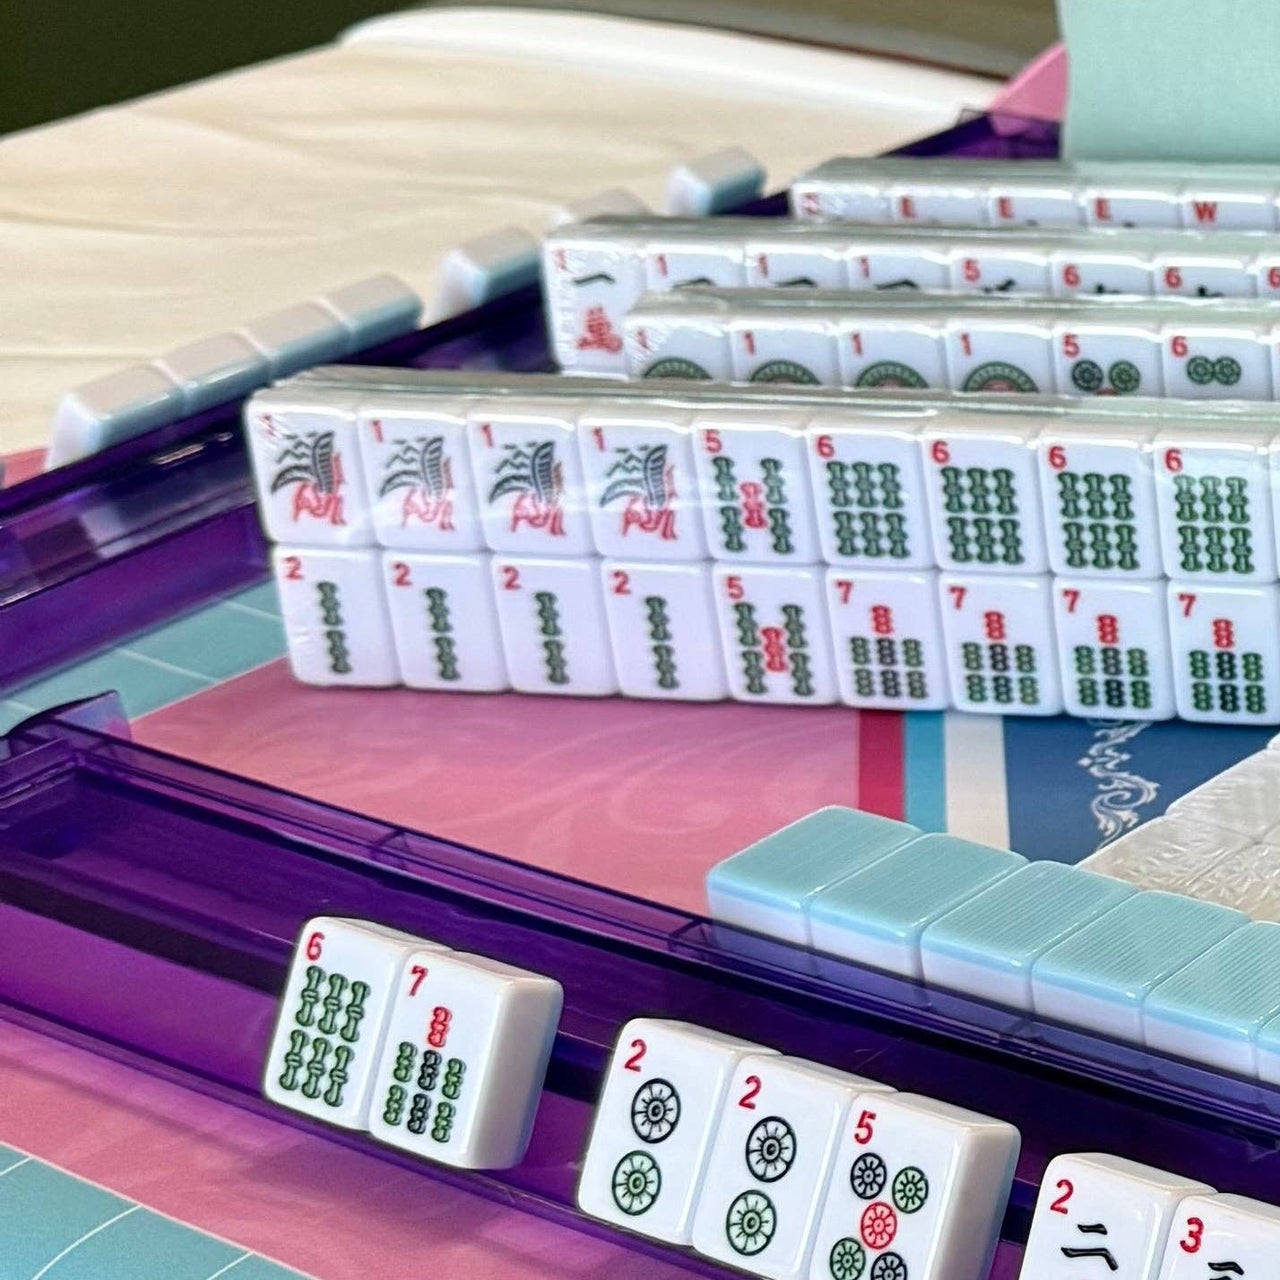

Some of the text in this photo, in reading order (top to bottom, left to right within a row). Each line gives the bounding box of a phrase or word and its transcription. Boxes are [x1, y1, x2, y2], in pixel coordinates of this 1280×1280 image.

[1194, 202, 1217, 222] W
[963, 259, 980, 281] 5
[1062, 265, 1080, 288] 6
[1163, 268, 1182, 289] 6
[1063, 332, 1079, 358] 5
[1170, 335, 1188, 358] 6
[702, 429, 722, 454] 5
[815, 434, 834, 459] 6
[930, 441, 950, 465] 6
[1047, 445, 1067, 471] 6
[1163, 448, 1182, 473] 6
[283, 556, 302, 582] 2
[394, 563, 410, 587] 2
[502, 566, 519, 591] 2
[612, 571, 629, 596] 2
[724, 575, 744, 601] 5
[836, 579, 854, 603] 7
[949, 586, 967, 609] 7
[1062, 589, 1080, 612] 7
[1178, 593, 1197, 615] 7
[305, 932, 323, 962] 6
[410, 965, 427, 994] 7
[624, 1039, 646, 1072] 2
[738, 1076, 762, 1110] 2
[854, 1111, 875, 1145] 5
[1050, 1179, 1074, 1214] 2
[1180, 1217, 1204, 1254] 3
